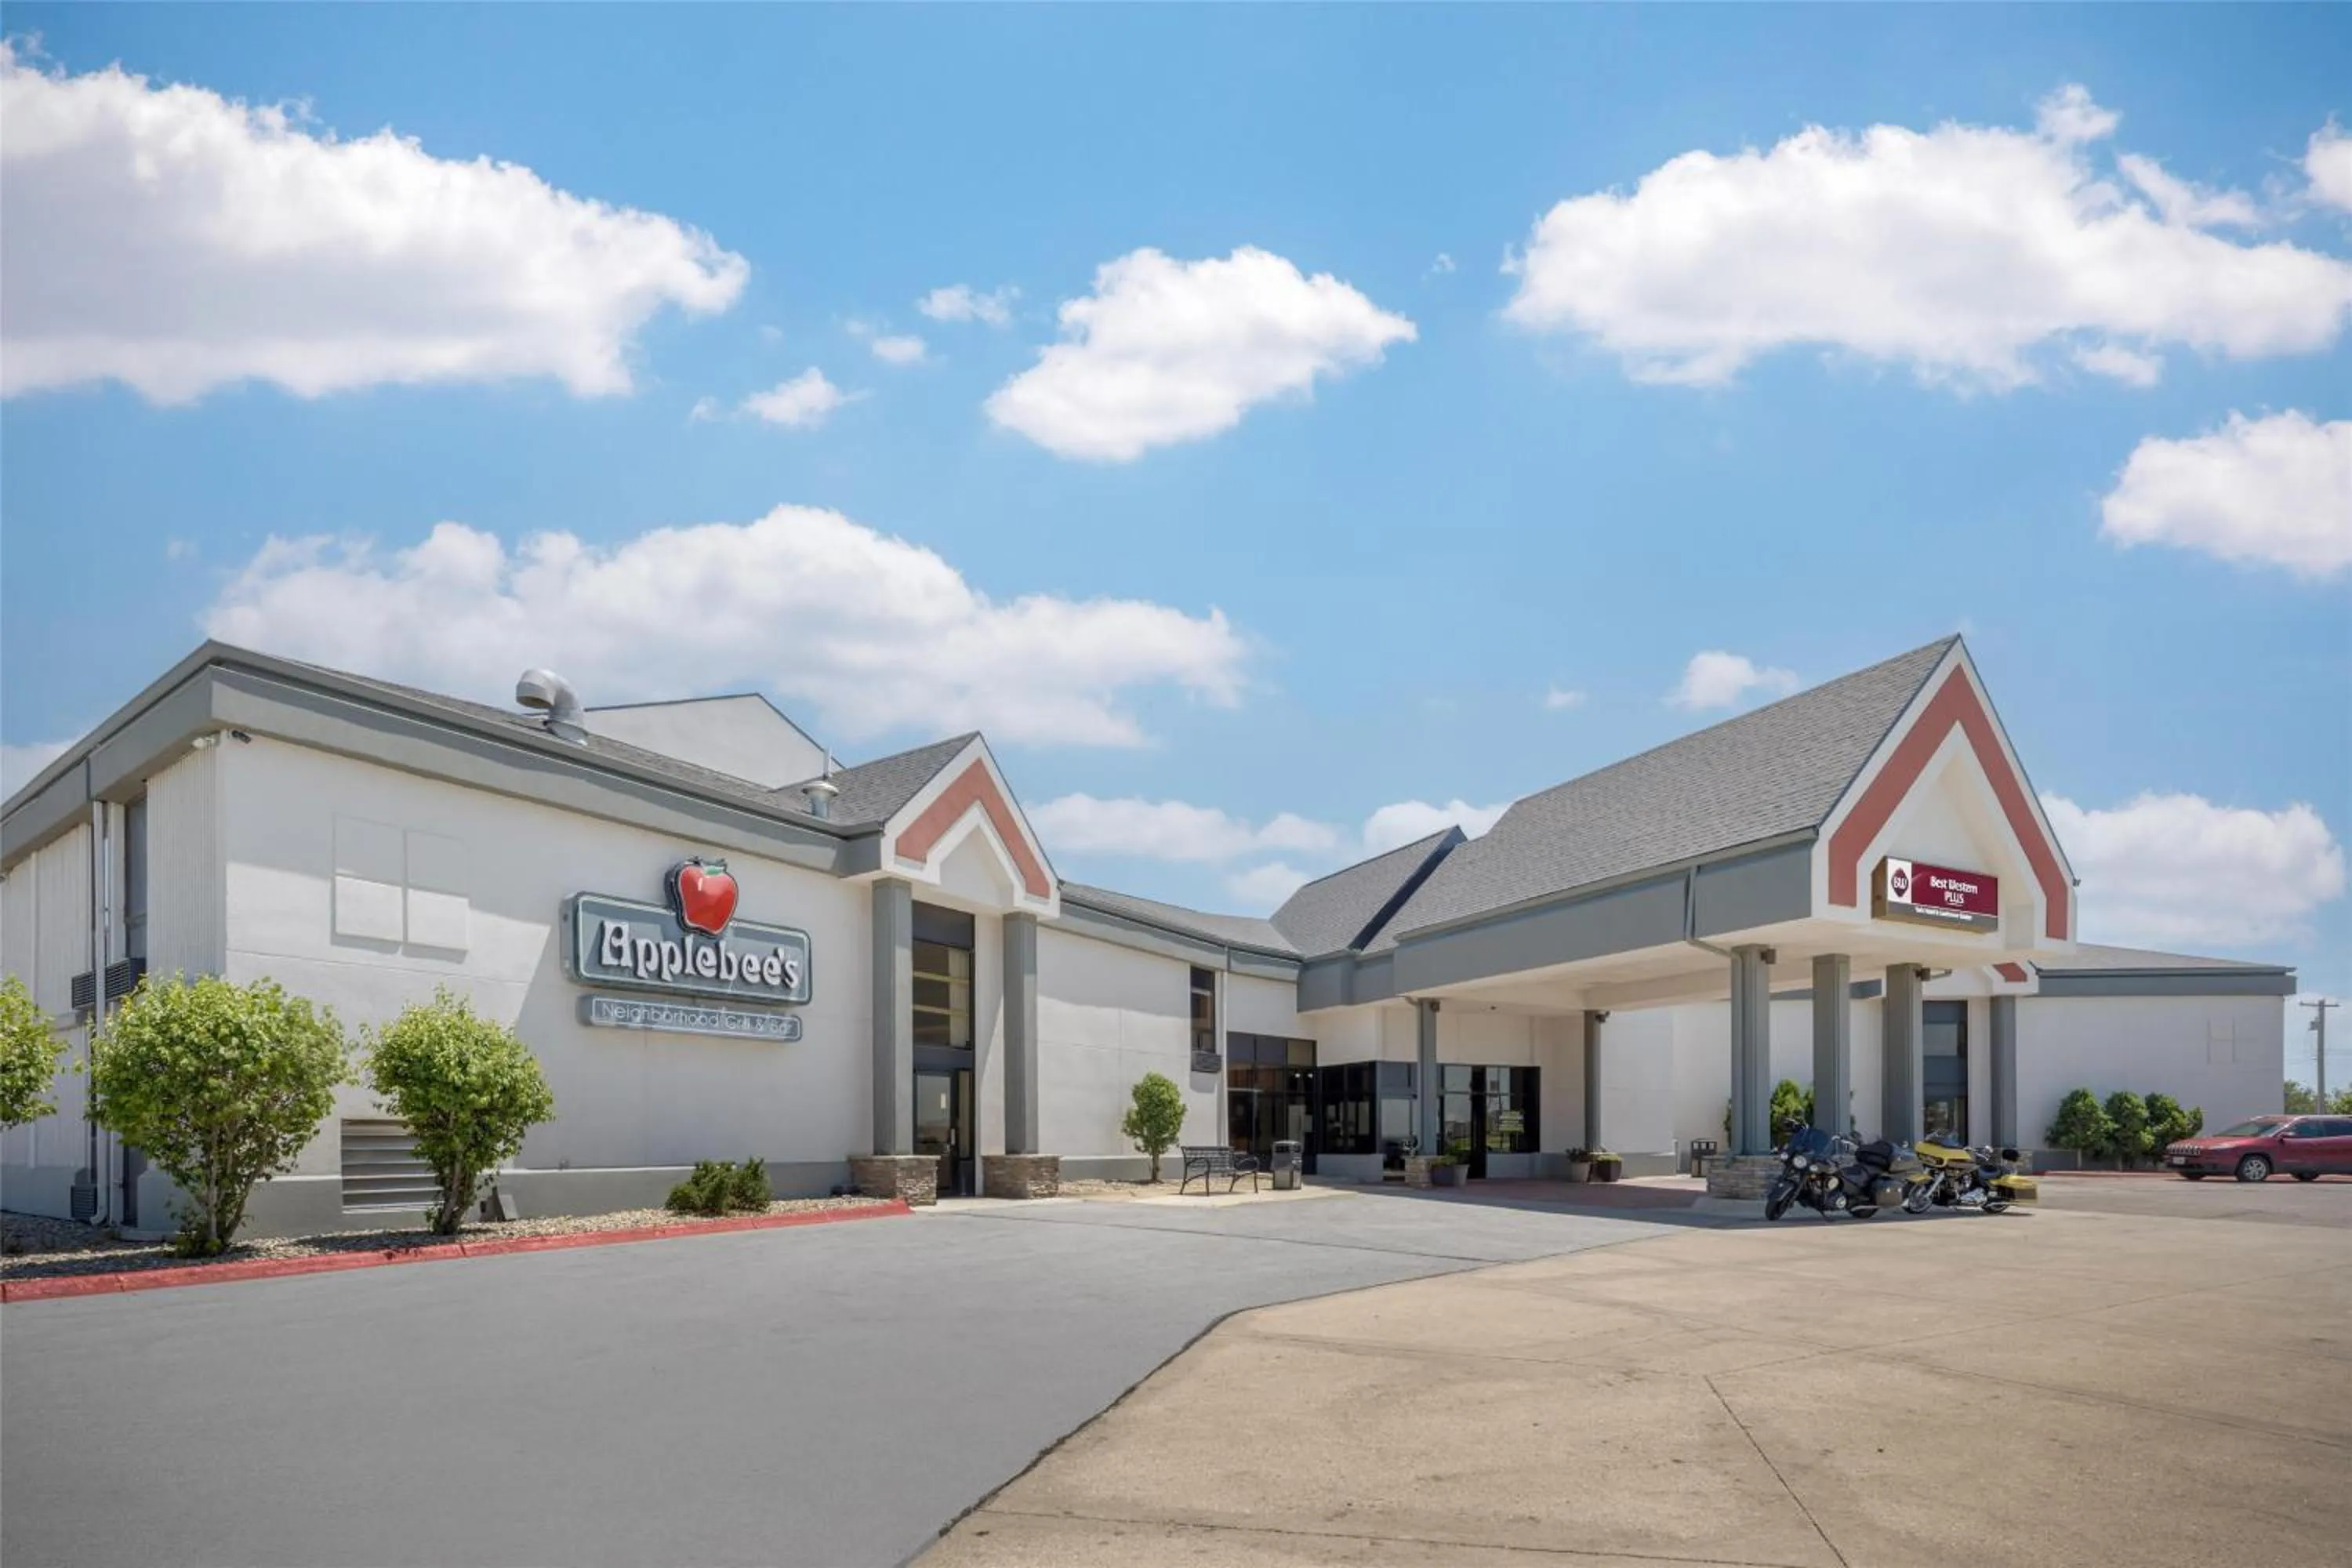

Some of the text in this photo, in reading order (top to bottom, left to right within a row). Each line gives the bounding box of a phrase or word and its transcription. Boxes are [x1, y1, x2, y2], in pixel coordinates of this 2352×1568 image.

[1930, 876, 1977, 894] Best Western
[1944, 891, 1964, 903] PLUS
[601, 920, 799, 989] Applebee's
[602, 1003, 719, 1027] Neighborhood
